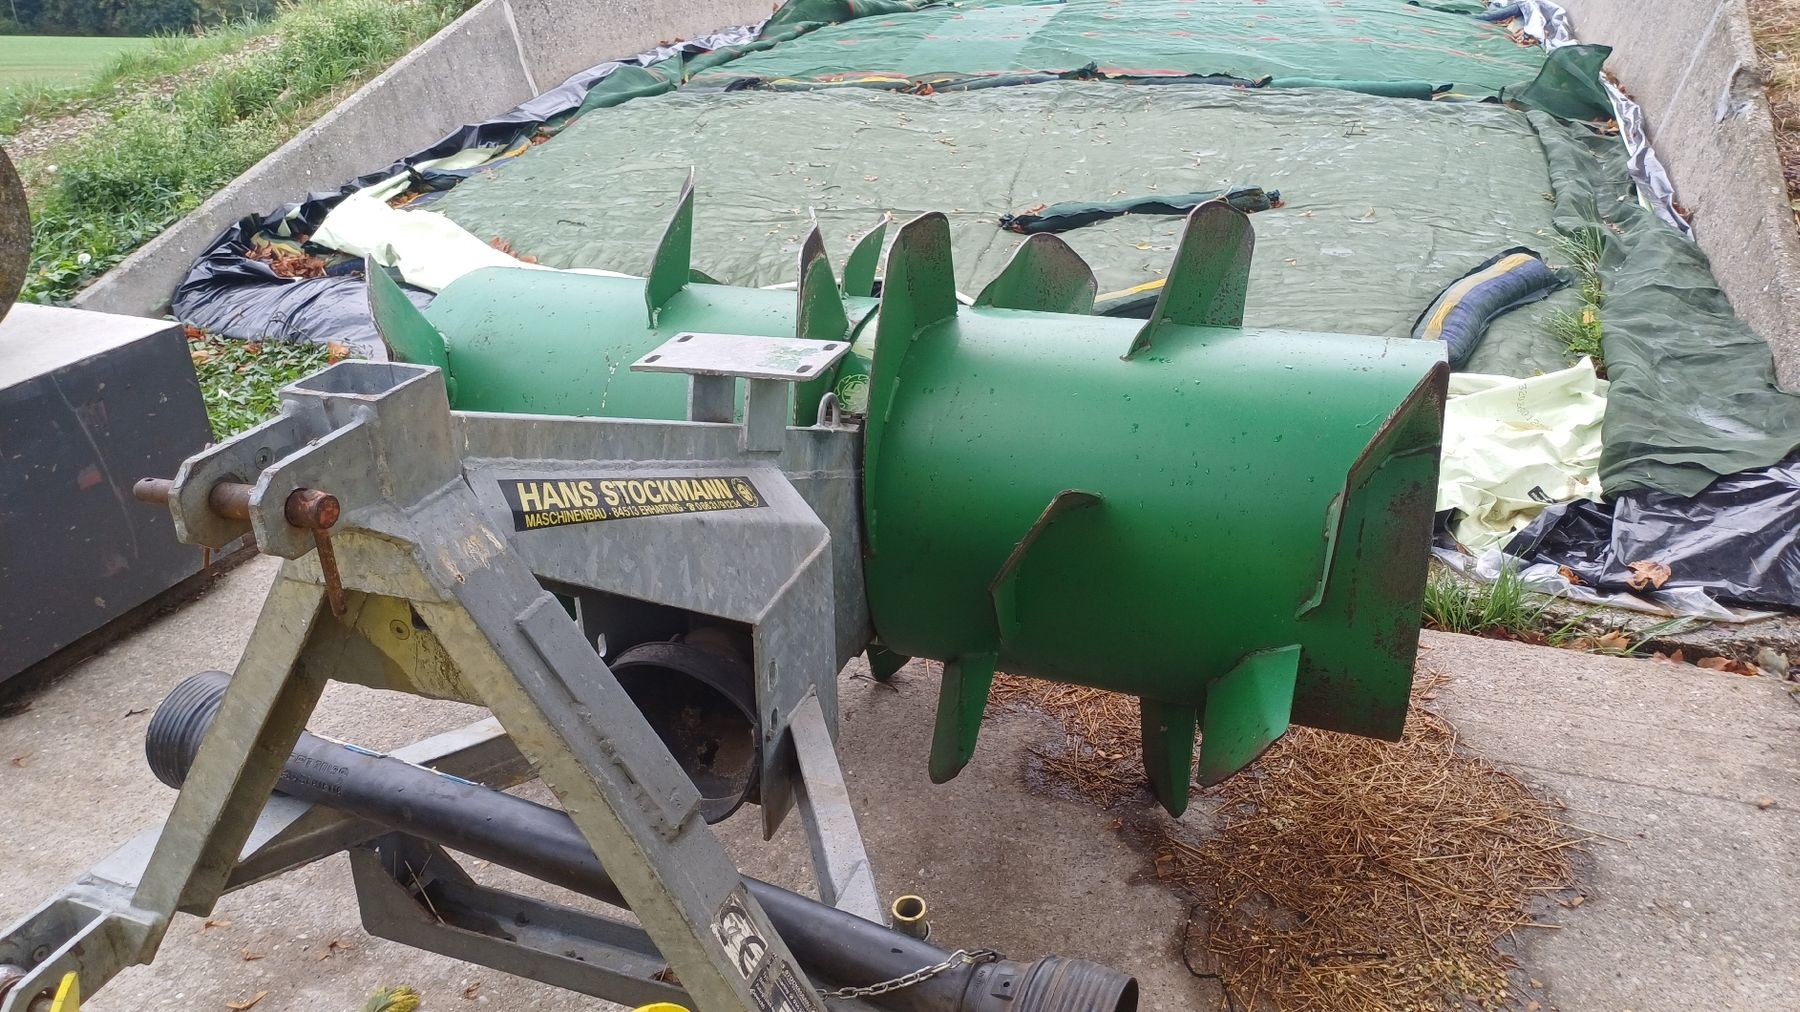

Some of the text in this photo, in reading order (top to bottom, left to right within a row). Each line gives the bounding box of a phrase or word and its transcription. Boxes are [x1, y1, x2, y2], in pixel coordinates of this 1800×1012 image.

[516, 478, 733, 512] HANS STOCKMANN
[525, 507, 607, 528] MASCHINENBAU
[611, 504, 639, 518] 84513
[639, 502, 684, 517] ERHARTING
